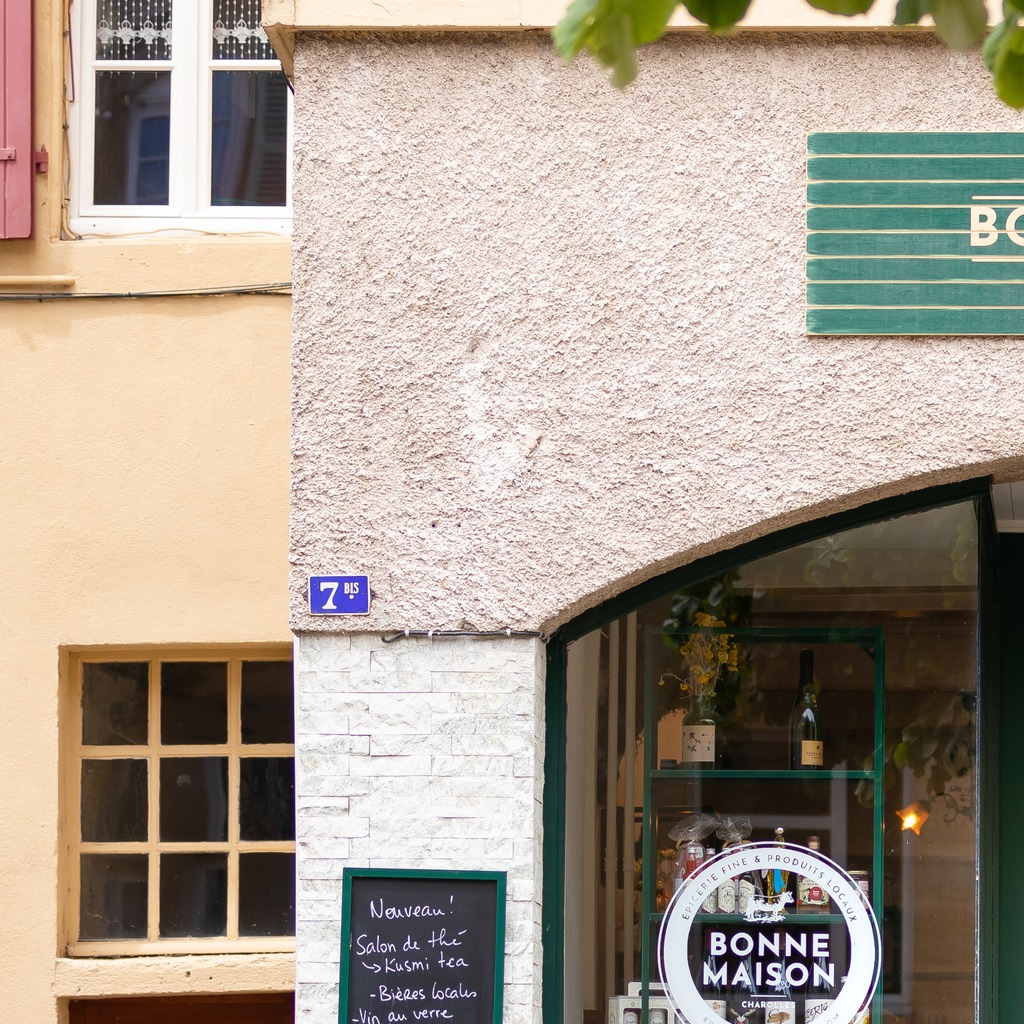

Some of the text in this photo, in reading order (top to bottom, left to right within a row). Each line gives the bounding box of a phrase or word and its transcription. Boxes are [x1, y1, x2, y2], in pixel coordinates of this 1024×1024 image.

[320, 581, 360, 609] 7 BIS
[721, 857, 748, 874] FINE
[754, 855, 761, 863] &
[767, 854, 825, 878] PRODUITS
[826, 878, 858, 923] LOCAUX
[356, 928, 468, 956] Salon de thé
[710, 932, 830, 957] BONNE
[384, 950, 470, 973] Kusmi tea
[702, 961, 835, 987] MAISON
[388, 1011, 407, 1022] au
[412, 1007, 454, 1019] verre
[741, 1000, 796, 1009] CHAROLLES
